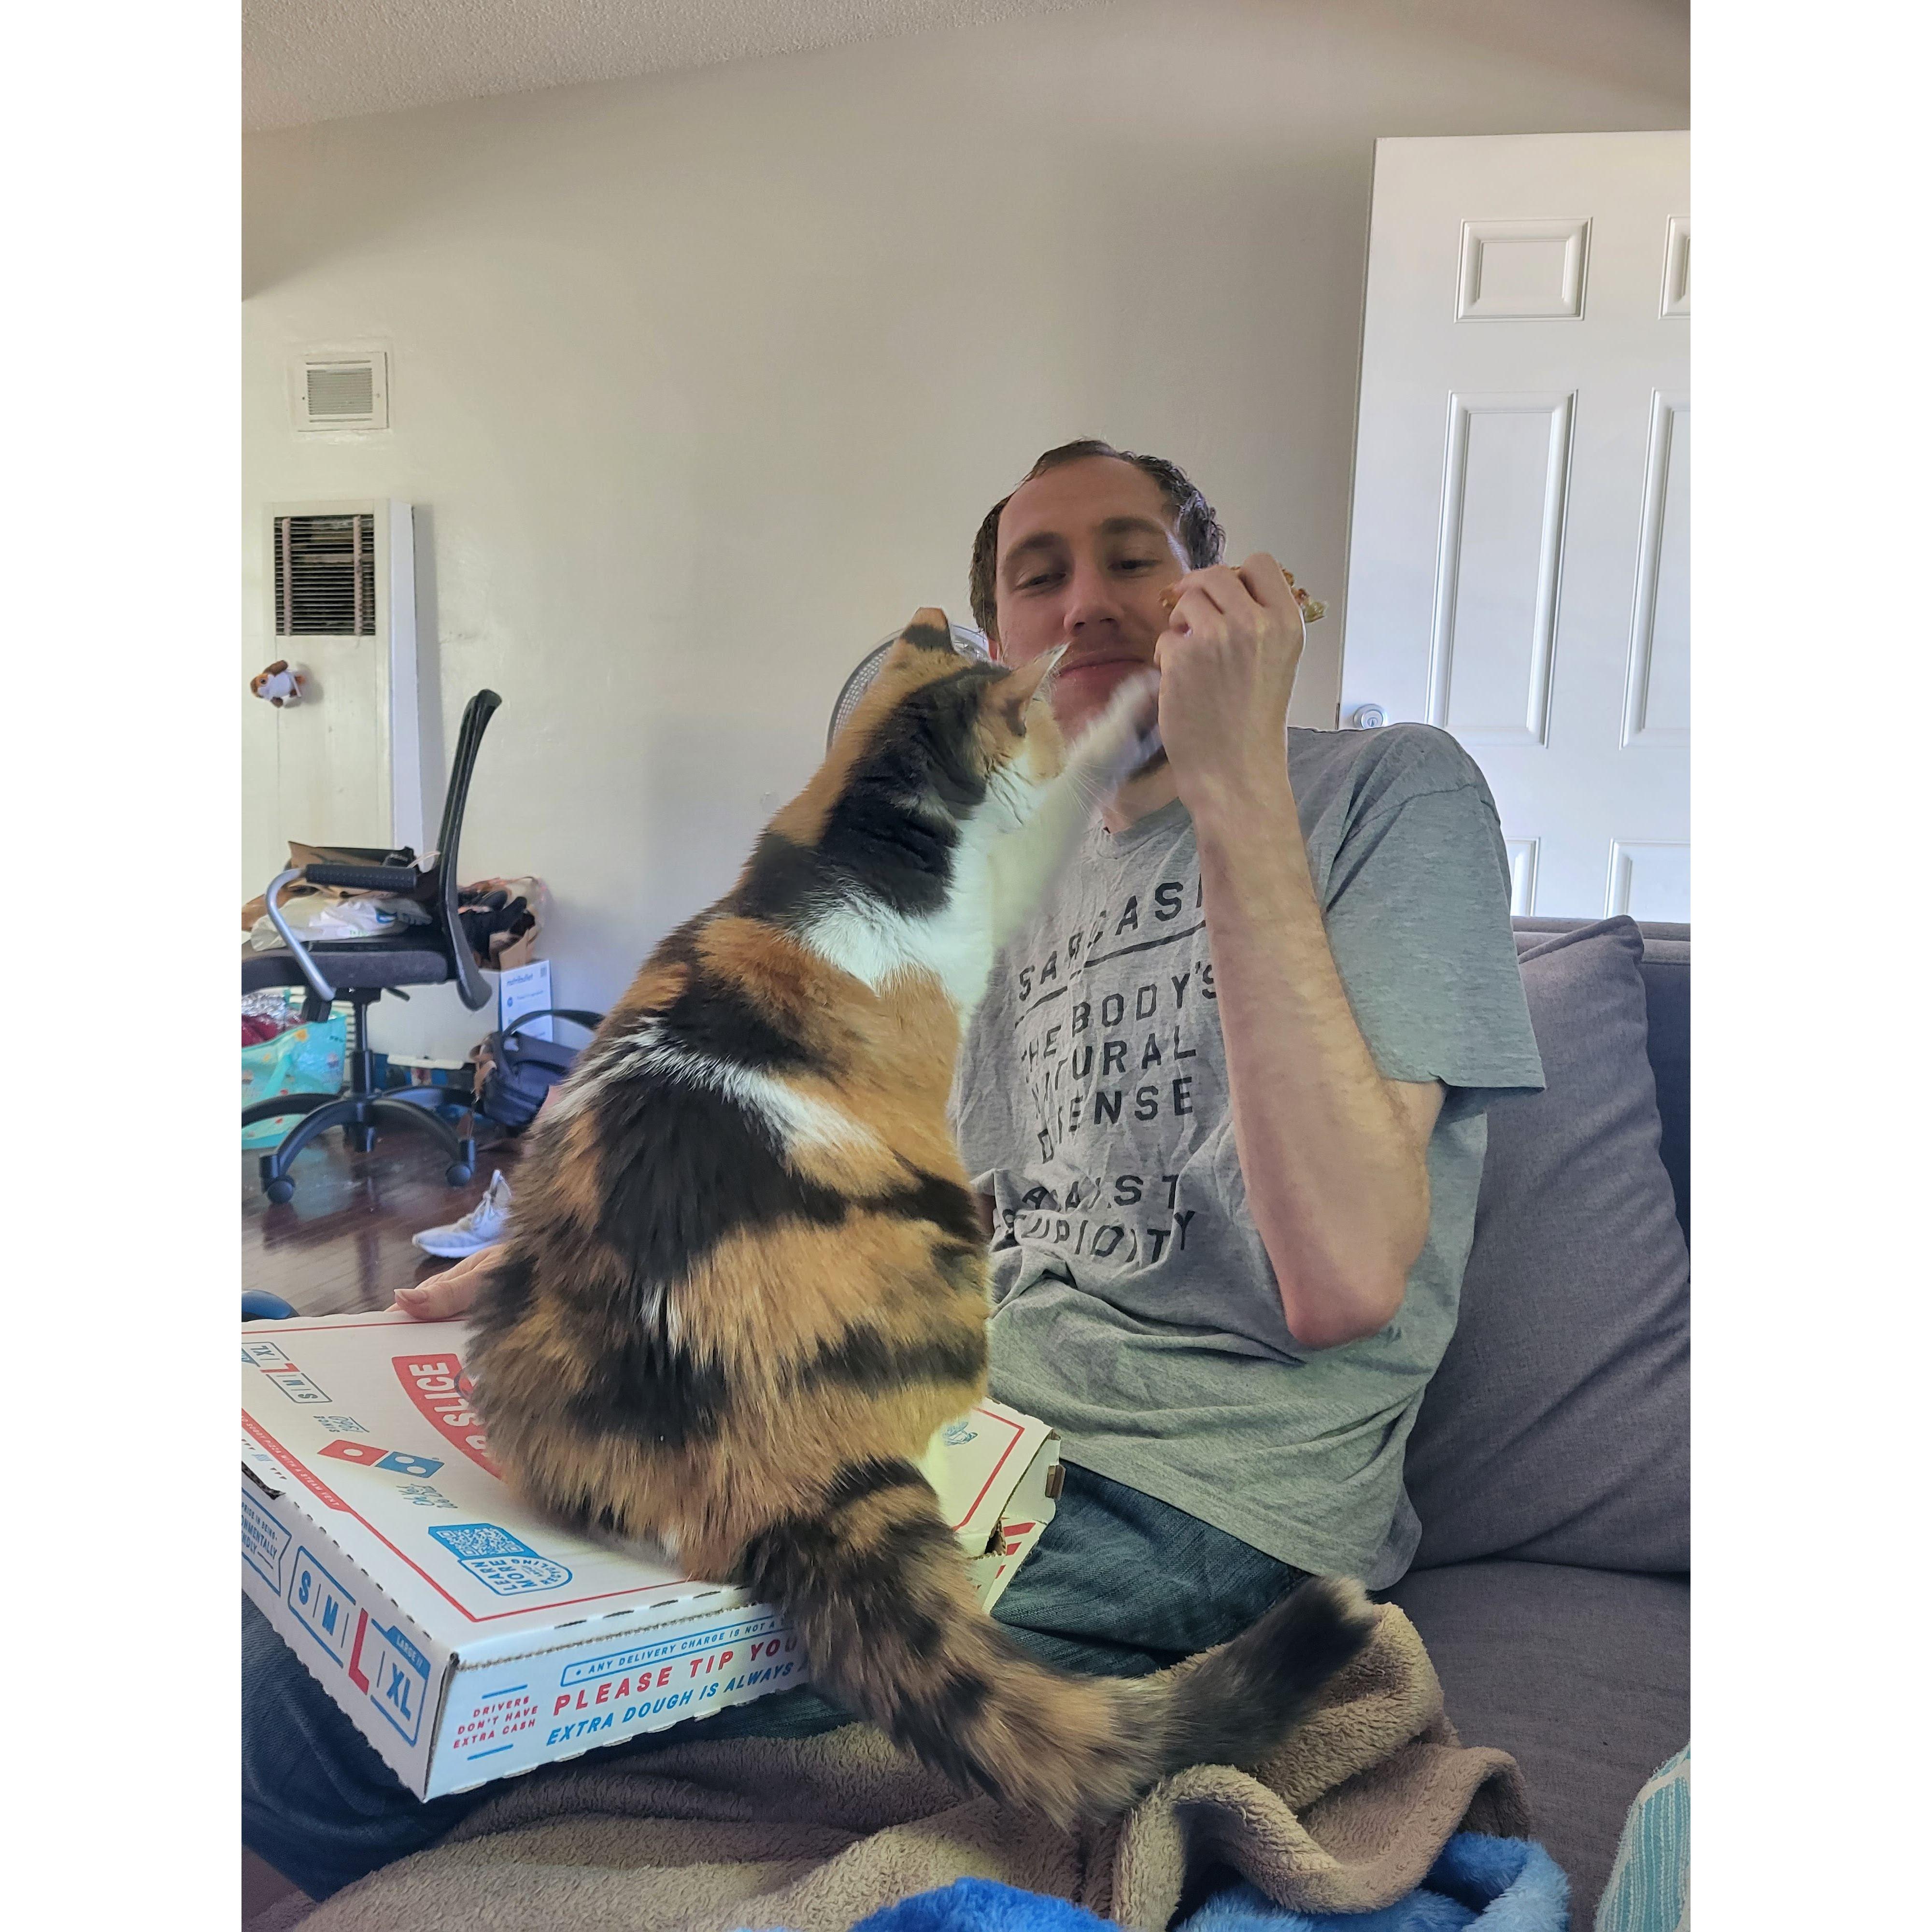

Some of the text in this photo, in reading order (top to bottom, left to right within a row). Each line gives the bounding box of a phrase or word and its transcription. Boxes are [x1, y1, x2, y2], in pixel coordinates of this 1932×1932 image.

[1019, 873, 1203, 1002] SARAS
[1071, 961, 1216, 1038] BODY'S
[250, 1345, 276, 1356] XL
[259, 1363, 301, 1374] L
[409, 1362, 484, 1427] SLICE
[265, 1439, 282, 1454] PIZZA
[280, 1454, 297, 1468] WITH
[300, 1473, 323, 1492] STEAM
[321, 1492, 341, 1506] VENT
[256, 1514, 261, 1525] IN
[242, 1530, 257, 1555] NDLY
[471, 1561, 518, 1591] LEARN
[488, 1559, 538, 1588] MORE
[298, 1570, 412, 1721] S M L XL
[588, 1661, 611, 1675] ANY
[619, 1644, 676, 1666] DELIVERY
[681, 1633, 724, 1650] CHARGE
[729, 1629, 740, 1638] IS
[745, 1622, 766, 1635] NOT
[553, 1666, 673, 1717] PLEASE
[689, 1650, 734, 1678] TIP
[458, 1705, 539, 1734] DON'T HAVE
[473, 1696, 530, 1718] DRIVERS
[546, 1712, 614, 1747] EXTRA
[622, 1689, 695, 1724] DOUGH
[698, 1682, 720, 1701] IS
[723, 1662, 795, 1693] ALWAYS
[453, 1718, 536, 1749] EXTRA CASH
